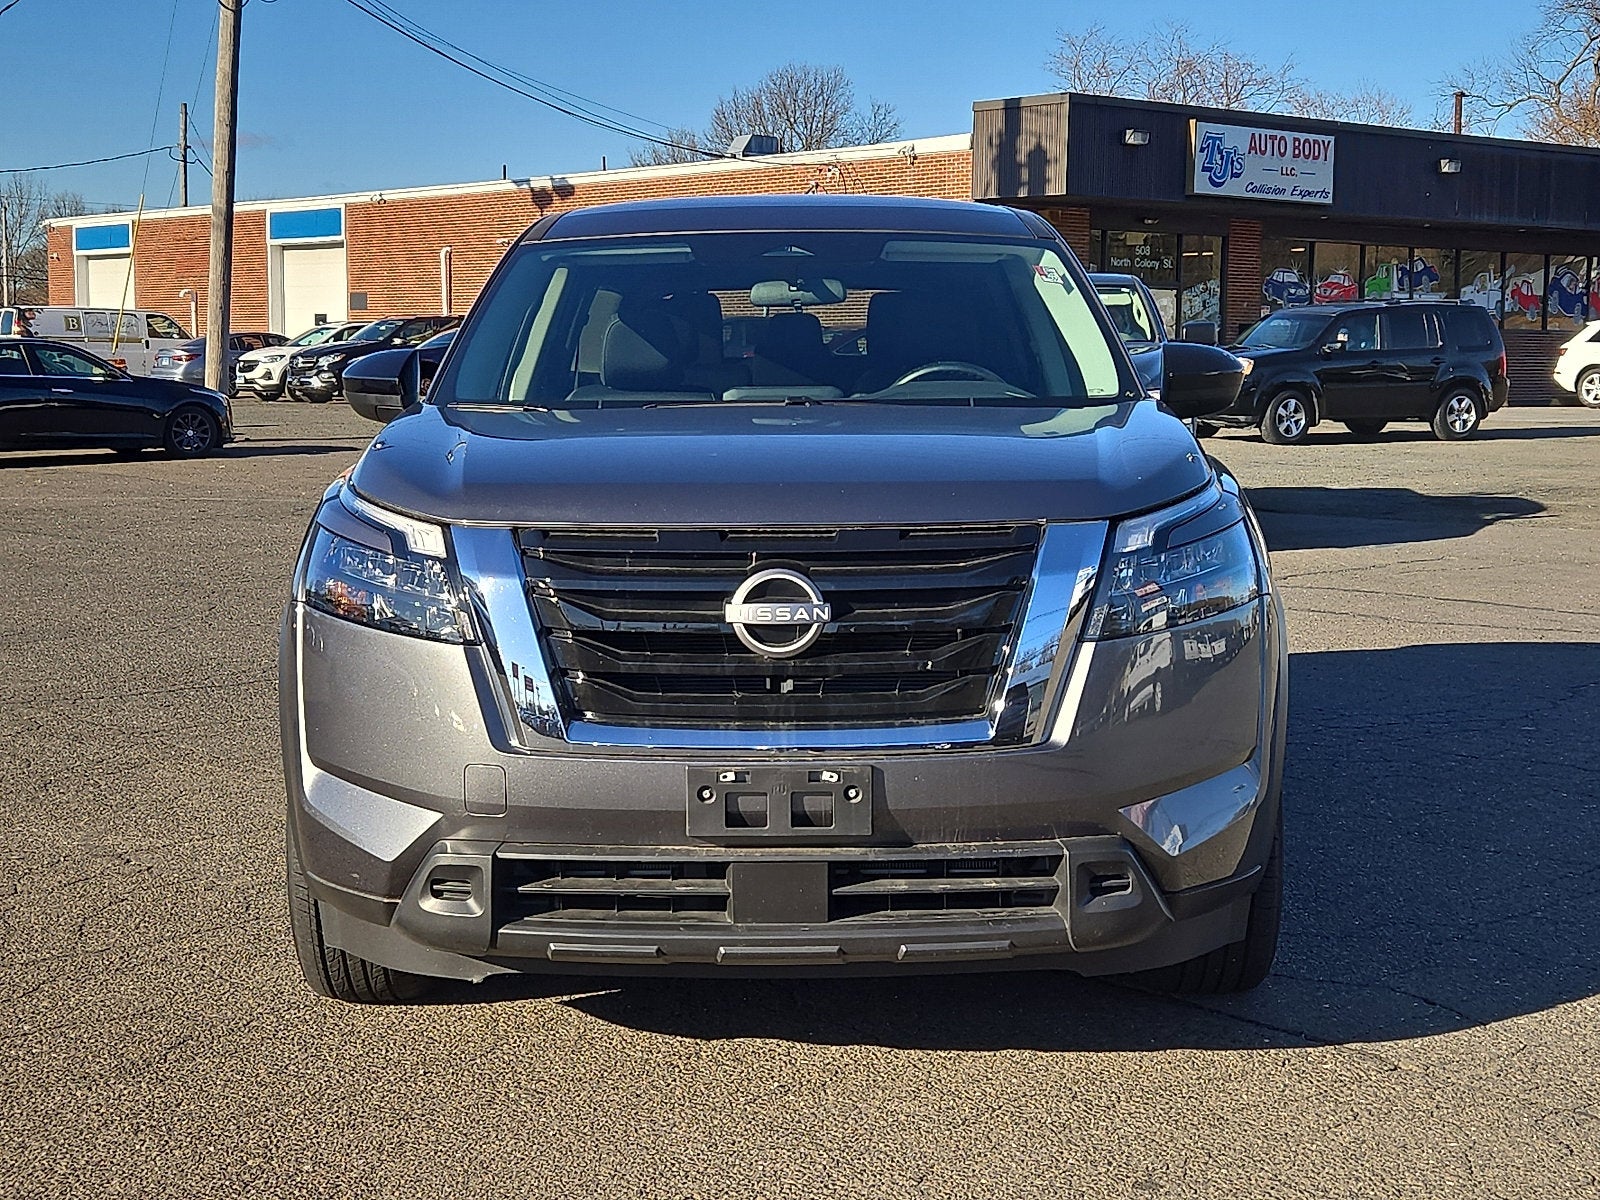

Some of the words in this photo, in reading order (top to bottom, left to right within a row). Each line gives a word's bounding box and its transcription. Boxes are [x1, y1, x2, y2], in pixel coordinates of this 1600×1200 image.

[1248, 132, 1288, 158] AUTO
[1292, 136, 1332, 162] BODY
[1200, 131, 1246, 188] TJ's
[1280, 166, 1298, 177] LLC.
[1245, 181, 1287, 196] Collision
[1290, 185, 1331, 200] Experts
[1110, 256, 1131, 267] North
[1134, 257, 1160, 270] Colony
[68, 317, 79, 330] B
[729, 606, 829, 621] NISSAN
